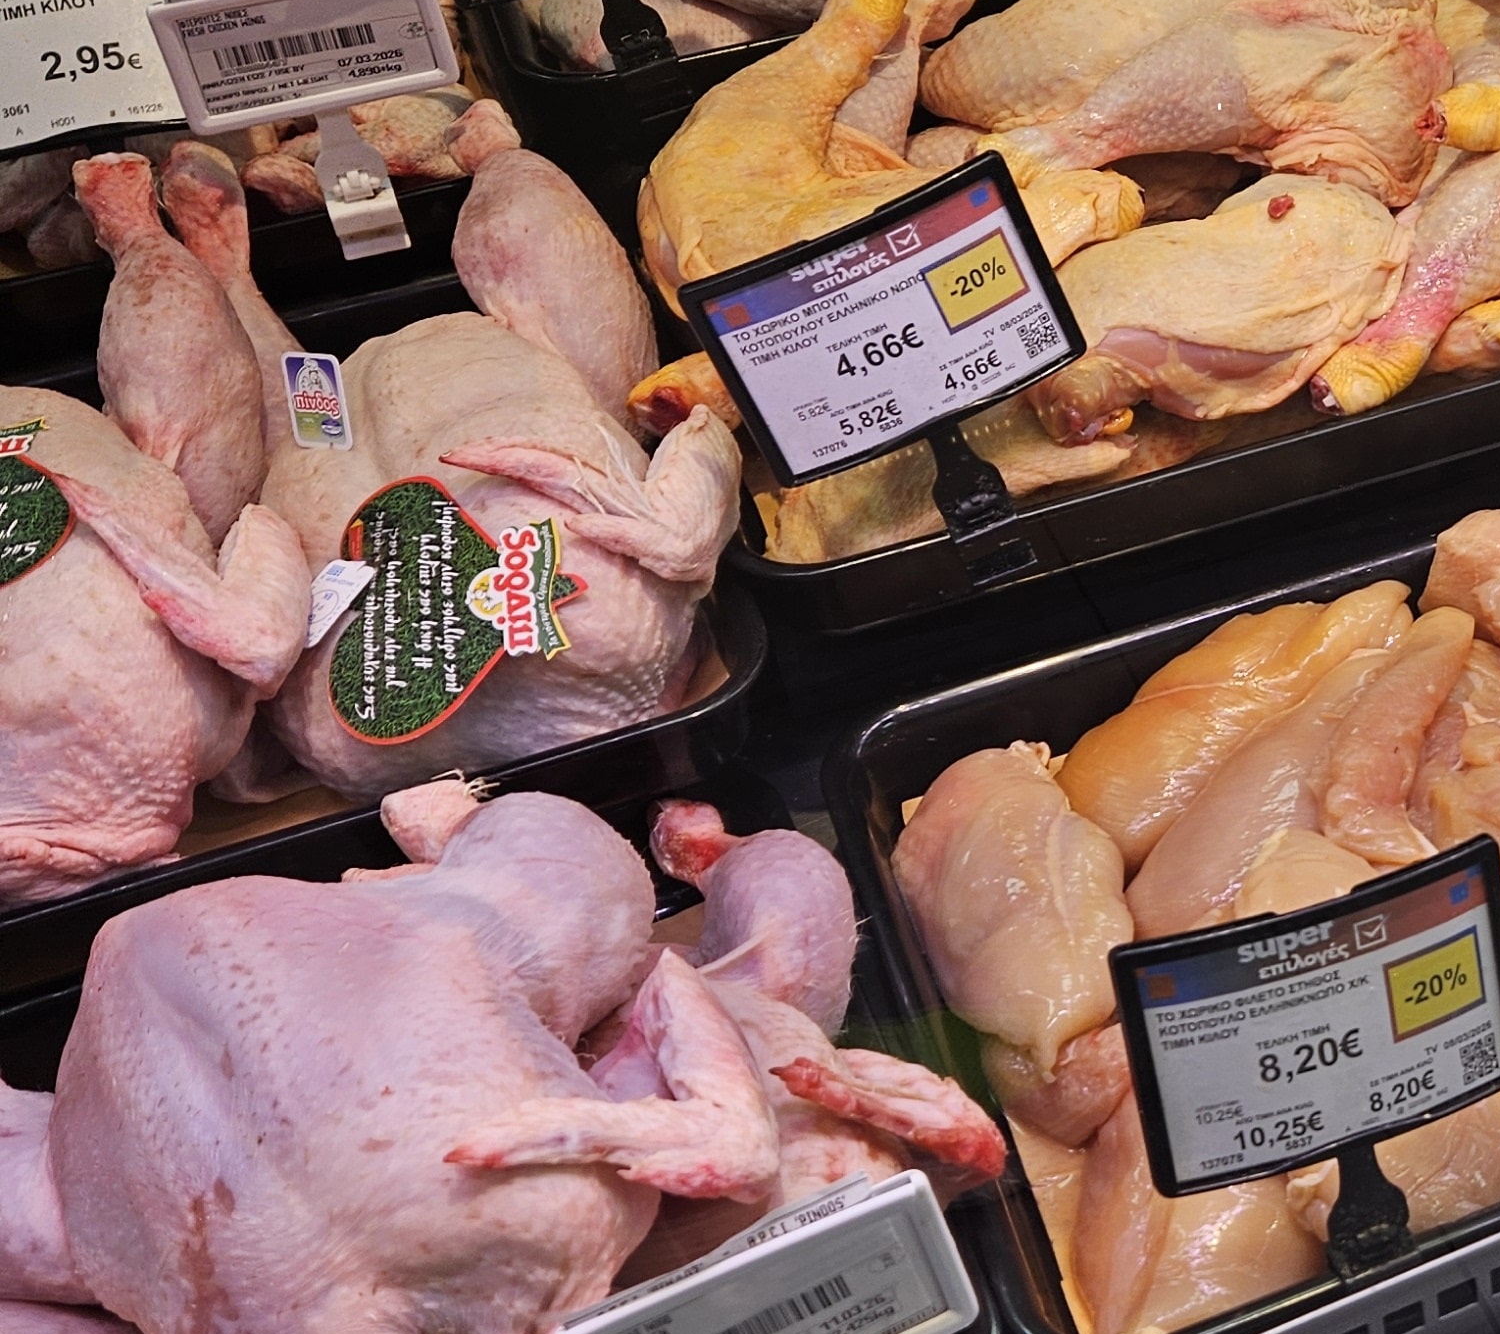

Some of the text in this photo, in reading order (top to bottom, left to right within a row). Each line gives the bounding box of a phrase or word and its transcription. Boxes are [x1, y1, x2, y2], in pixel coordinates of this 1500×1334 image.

[40, 41, 143, 82] 2,95€
[337, 48, 404, 67] 07.03.2026
[811, 251, 891, 294] επιλογές
[948, 256, 1007, 298] -20%
[732, 292, 849, 344] ΤΟ ΧΩΡΙΚΟ ΜΠΟΥΤΙ
[740, 318, 825, 357] ΚΟΤΟΠΟΥΛΟΥ
[827, 289, 889, 323] ΕΛΛΗΝΙΚΟ
[983, 302, 1044, 339] TV 08/03/2026
[749, 334, 820, 368] ΤΙΜΗ ΚΙΛΟΥ
[825, 323, 888, 353] ΤΕΛΙΚΗ ΤΙΜΗ
[836, 322, 924, 378] 4,66€
[945, 349, 1002, 390] 4,66€
[294, 390, 340, 418] πίνδος
[839, 399, 902, 436] 5,82€
[812, 439, 848, 457] 137076
[413, 532, 439, 587] επιλογή
[440, 561, 460, 599] στην
[495, 529, 537, 650] πίνδος
[419, 590, 432, 617] σας
[386, 630, 403, 661] την
[384, 662, 408, 690] για
[444, 662, 465, 694] μας
[1237, 920, 1335, 964] super
[1258, 942, 1351, 982] επιλογές
[1155, 970, 1341, 1025] ΤΟ ΧΩΡΙΚΟ ΦΙΛΕΤΟ ΣΤΗΘΟΣ
[1403, 963, 1468, 1006] -20%
[1158, 1011, 1246, 1038] ΚΟΤΟΠΟΥΛΟ
[1160, 1027, 1240, 1051] ΤΙΜΗ ΚΙΛΟΥ
[1255, 1023, 1331, 1051] ΤΕΛΙΚΗ ΤΙΜΗ
[1259, 1028, 1364, 1084] 8,20€
[1424, 1043, 1439, 1056] TV
[1370, 1069, 1436, 1112] 8,20€
[1233, 1110, 1324, 1151] 10,25€
[1285, 1136, 1313, 1151] 5837
[819, 1293, 885, 1331] 11.03.26
